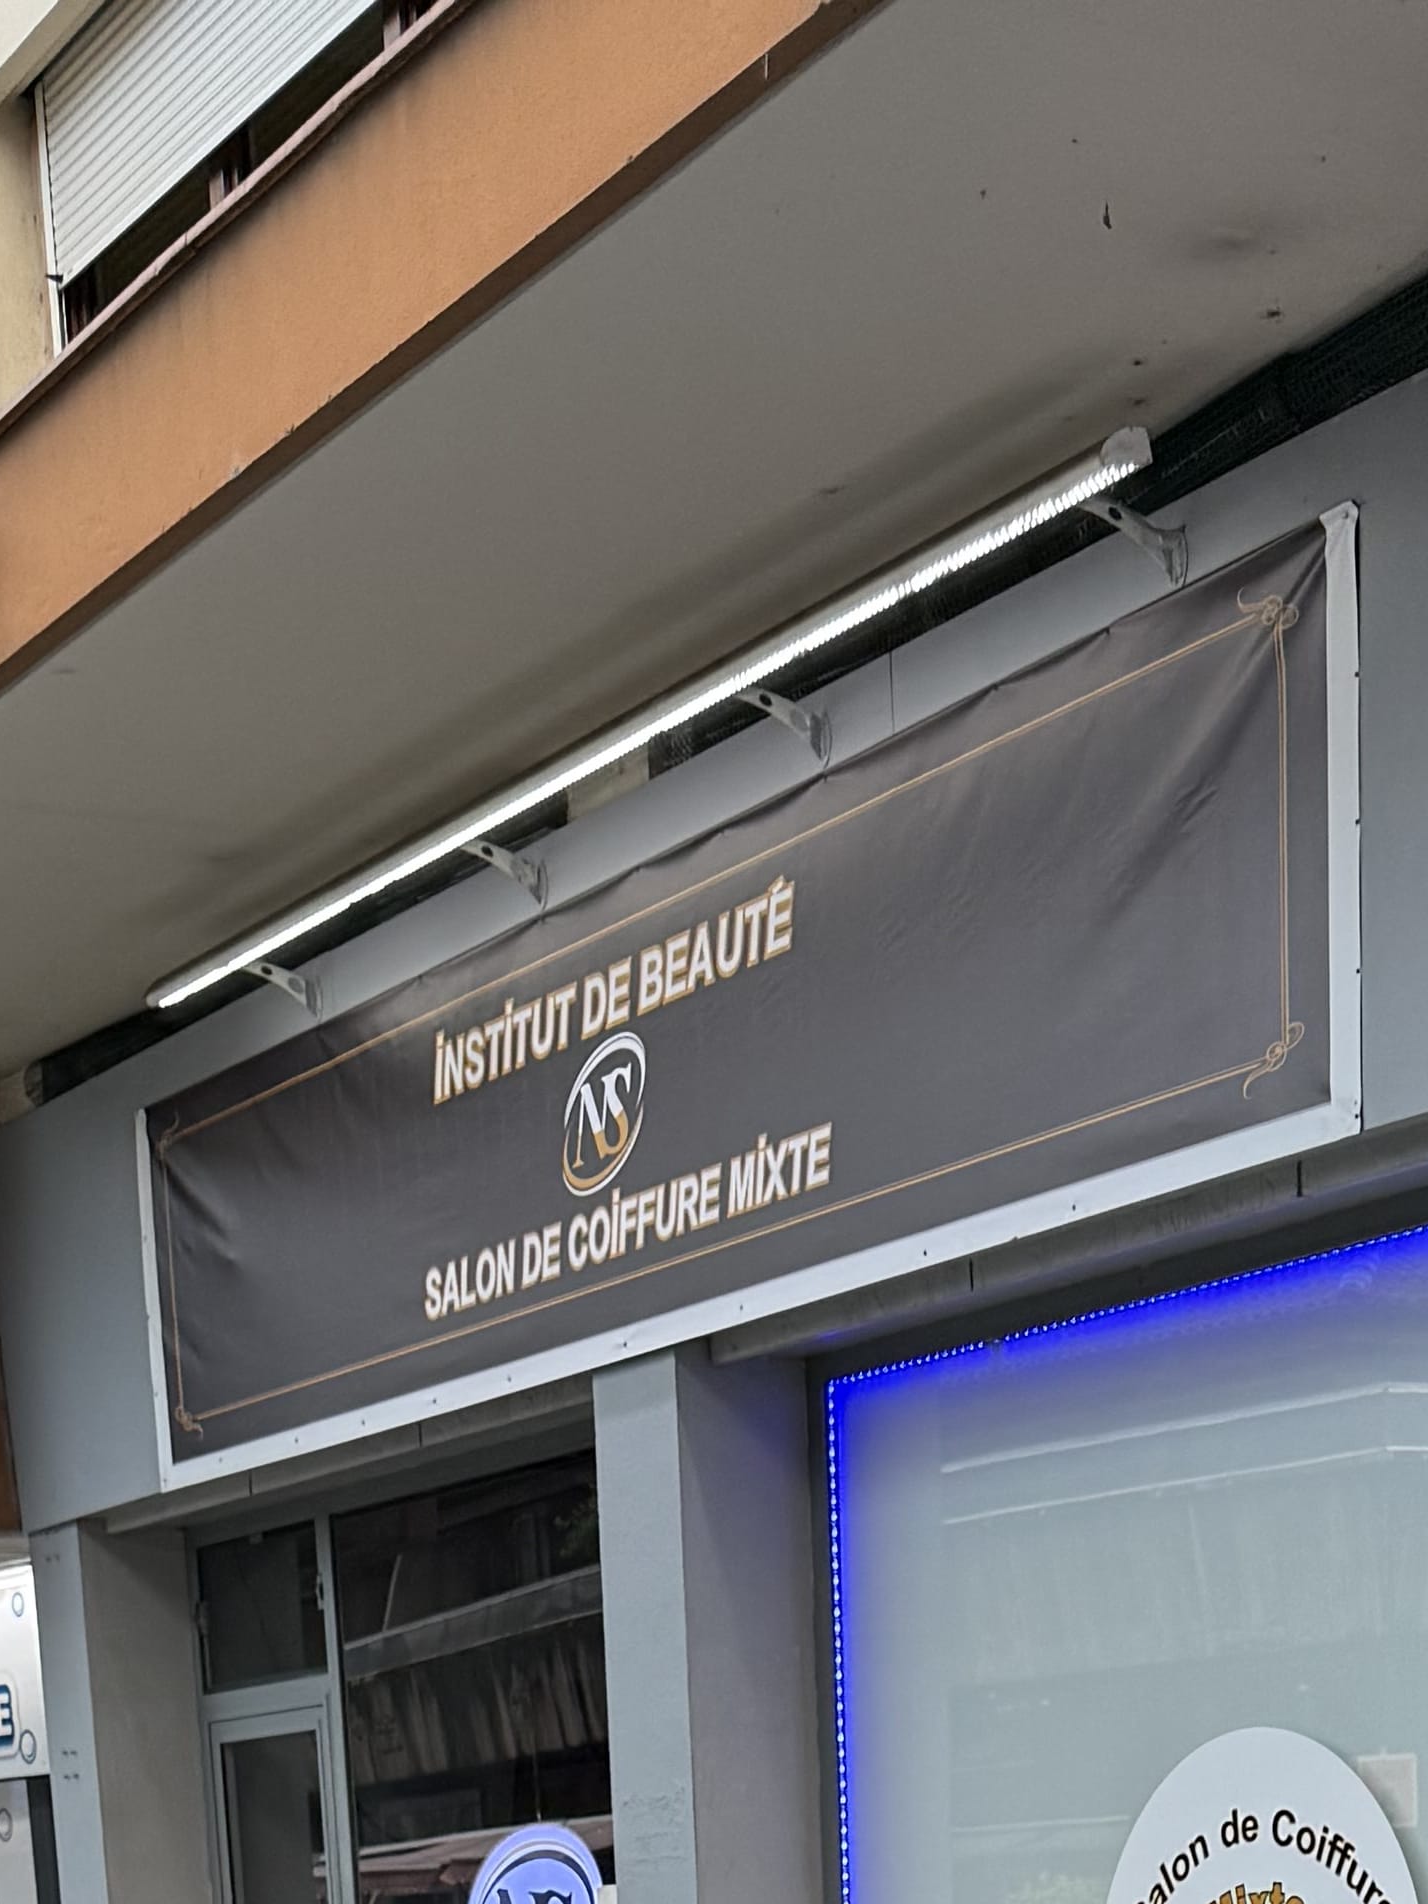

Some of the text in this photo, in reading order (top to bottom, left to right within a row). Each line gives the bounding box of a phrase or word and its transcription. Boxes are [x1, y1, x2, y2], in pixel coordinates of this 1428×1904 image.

[580, 957, 632, 1039] DE
[638, 876, 796, 1016] BEAUTÉ
[424, 1249, 515, 1322] SALON
[521, 1223, 562, 1292] DE
[1221, 1809, 1259, 1847] de
